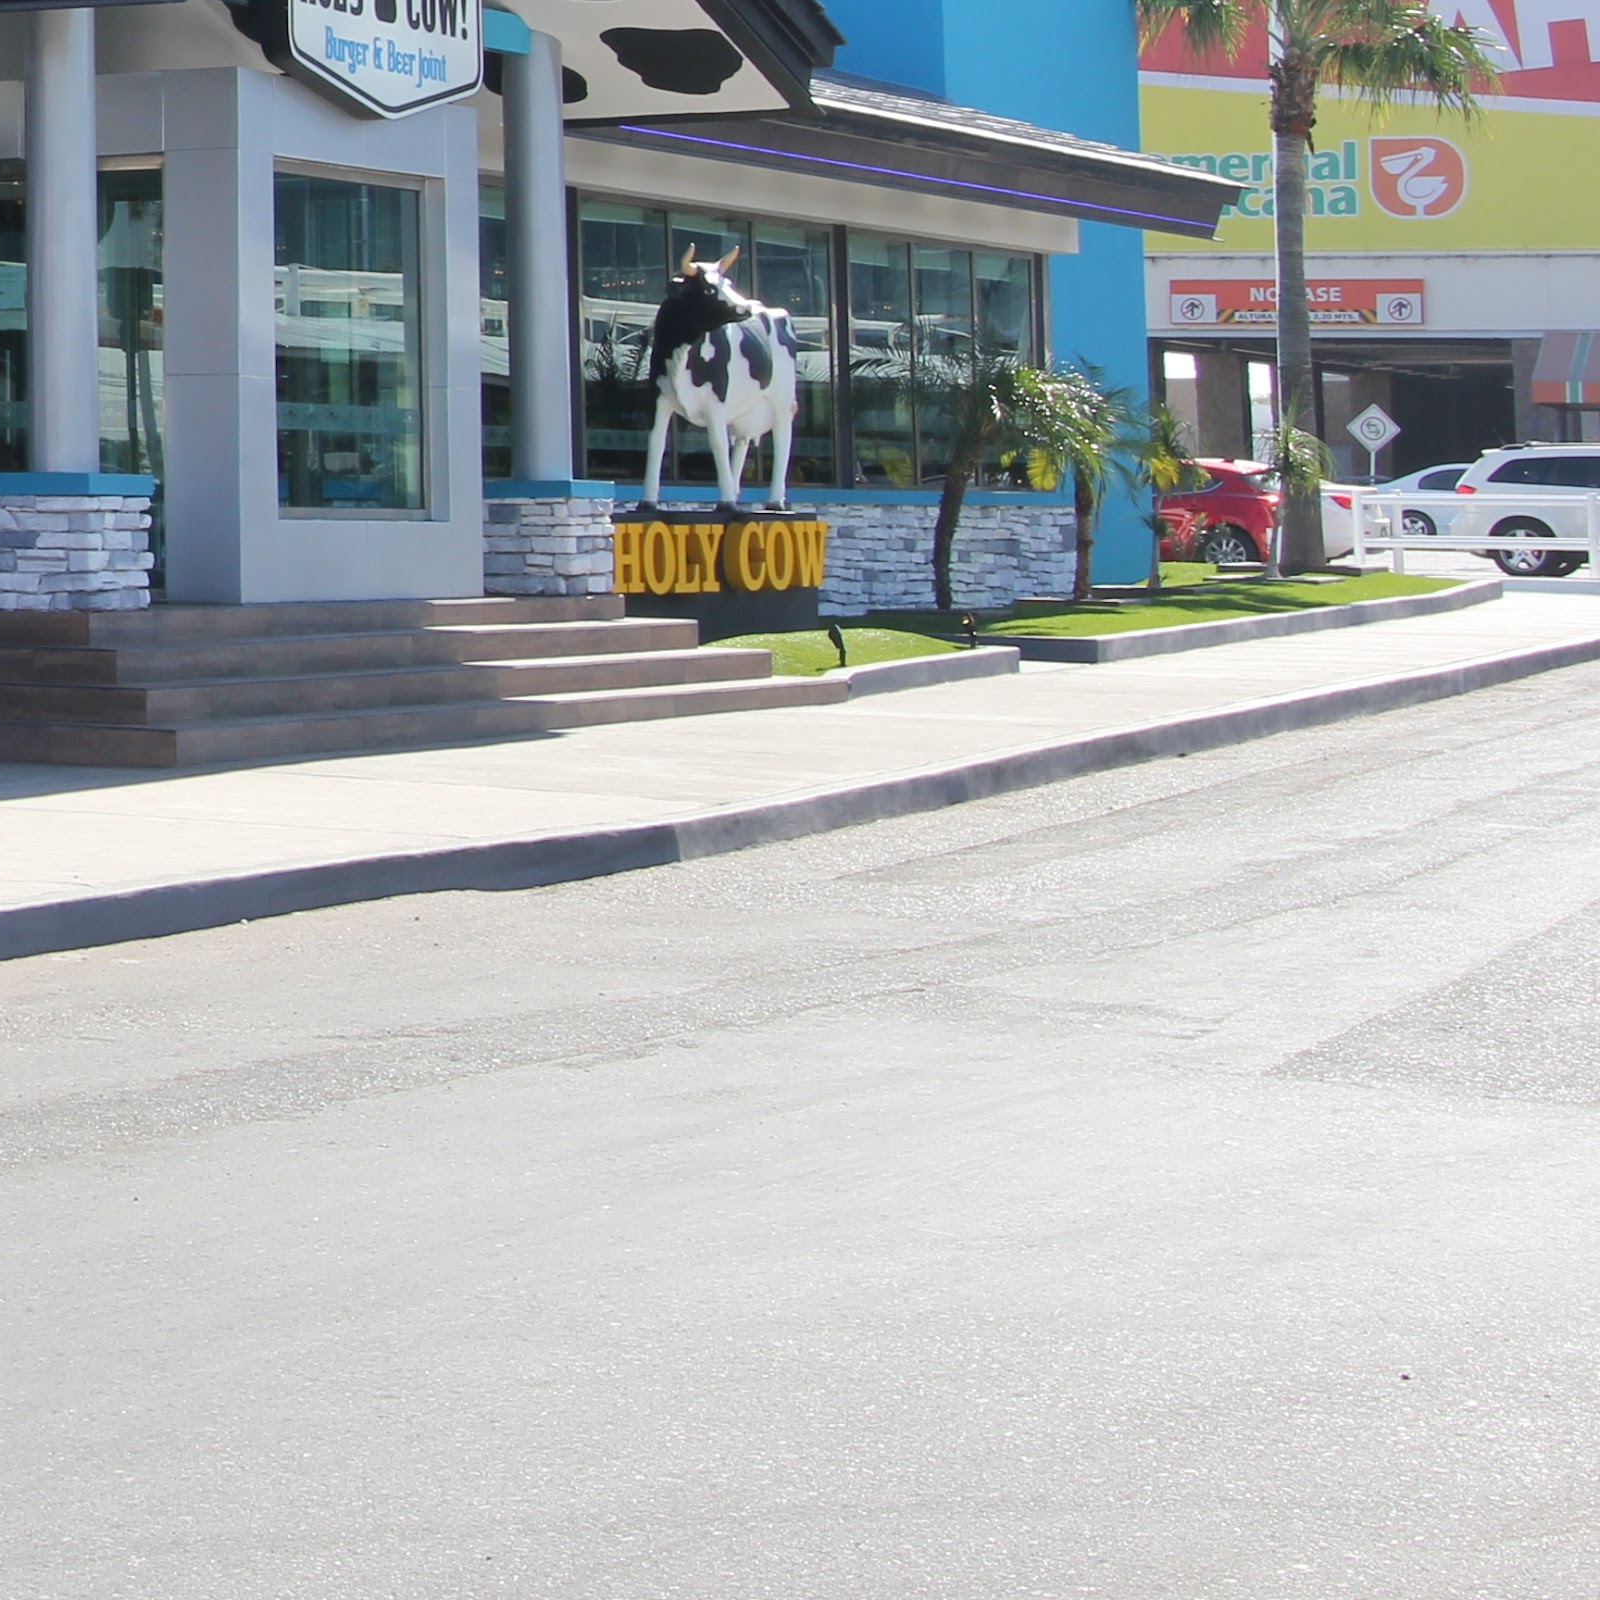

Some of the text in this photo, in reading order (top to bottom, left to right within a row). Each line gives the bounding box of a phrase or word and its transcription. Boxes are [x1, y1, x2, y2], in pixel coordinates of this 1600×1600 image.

[324, 25, 448, 88] Burger & Beer Joint
[613, 521, 829, 595] HOLY COW
